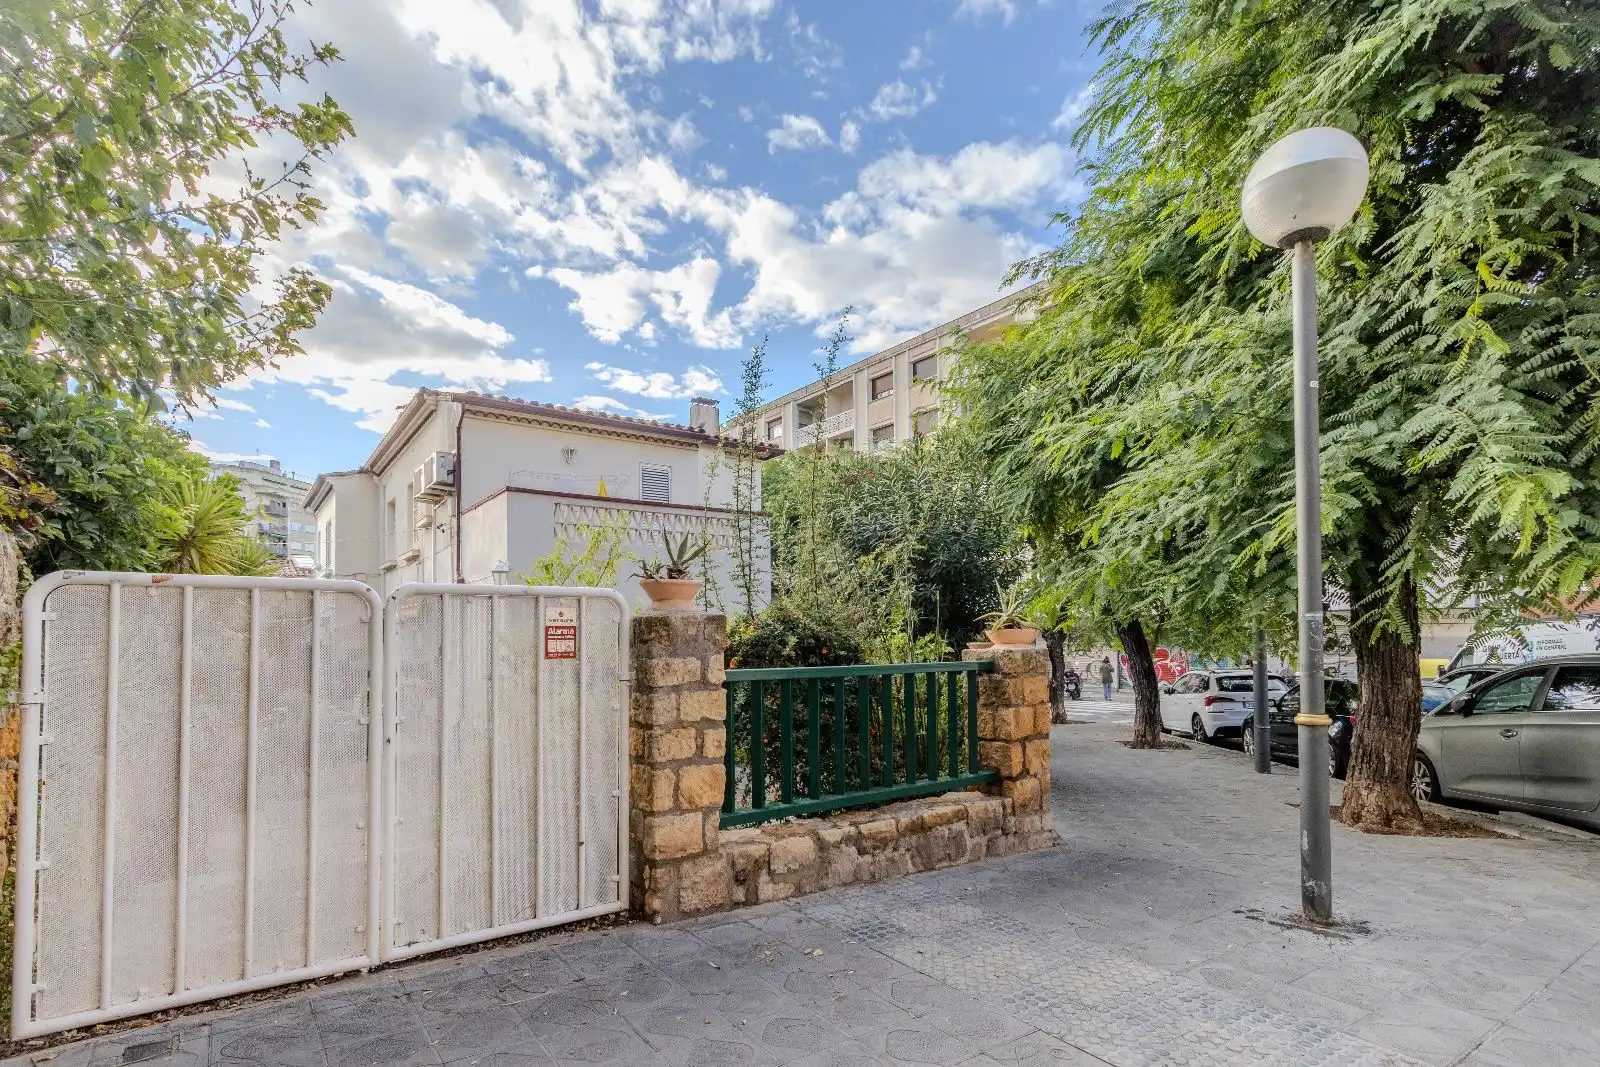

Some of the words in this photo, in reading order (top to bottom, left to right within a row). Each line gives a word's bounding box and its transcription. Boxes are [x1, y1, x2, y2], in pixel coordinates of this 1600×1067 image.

[548, 627, 574, 635] Alarma
[1536, 638, 1563, 646] REFORMAS
[1543, 643, 1567, 651] GENERAL
